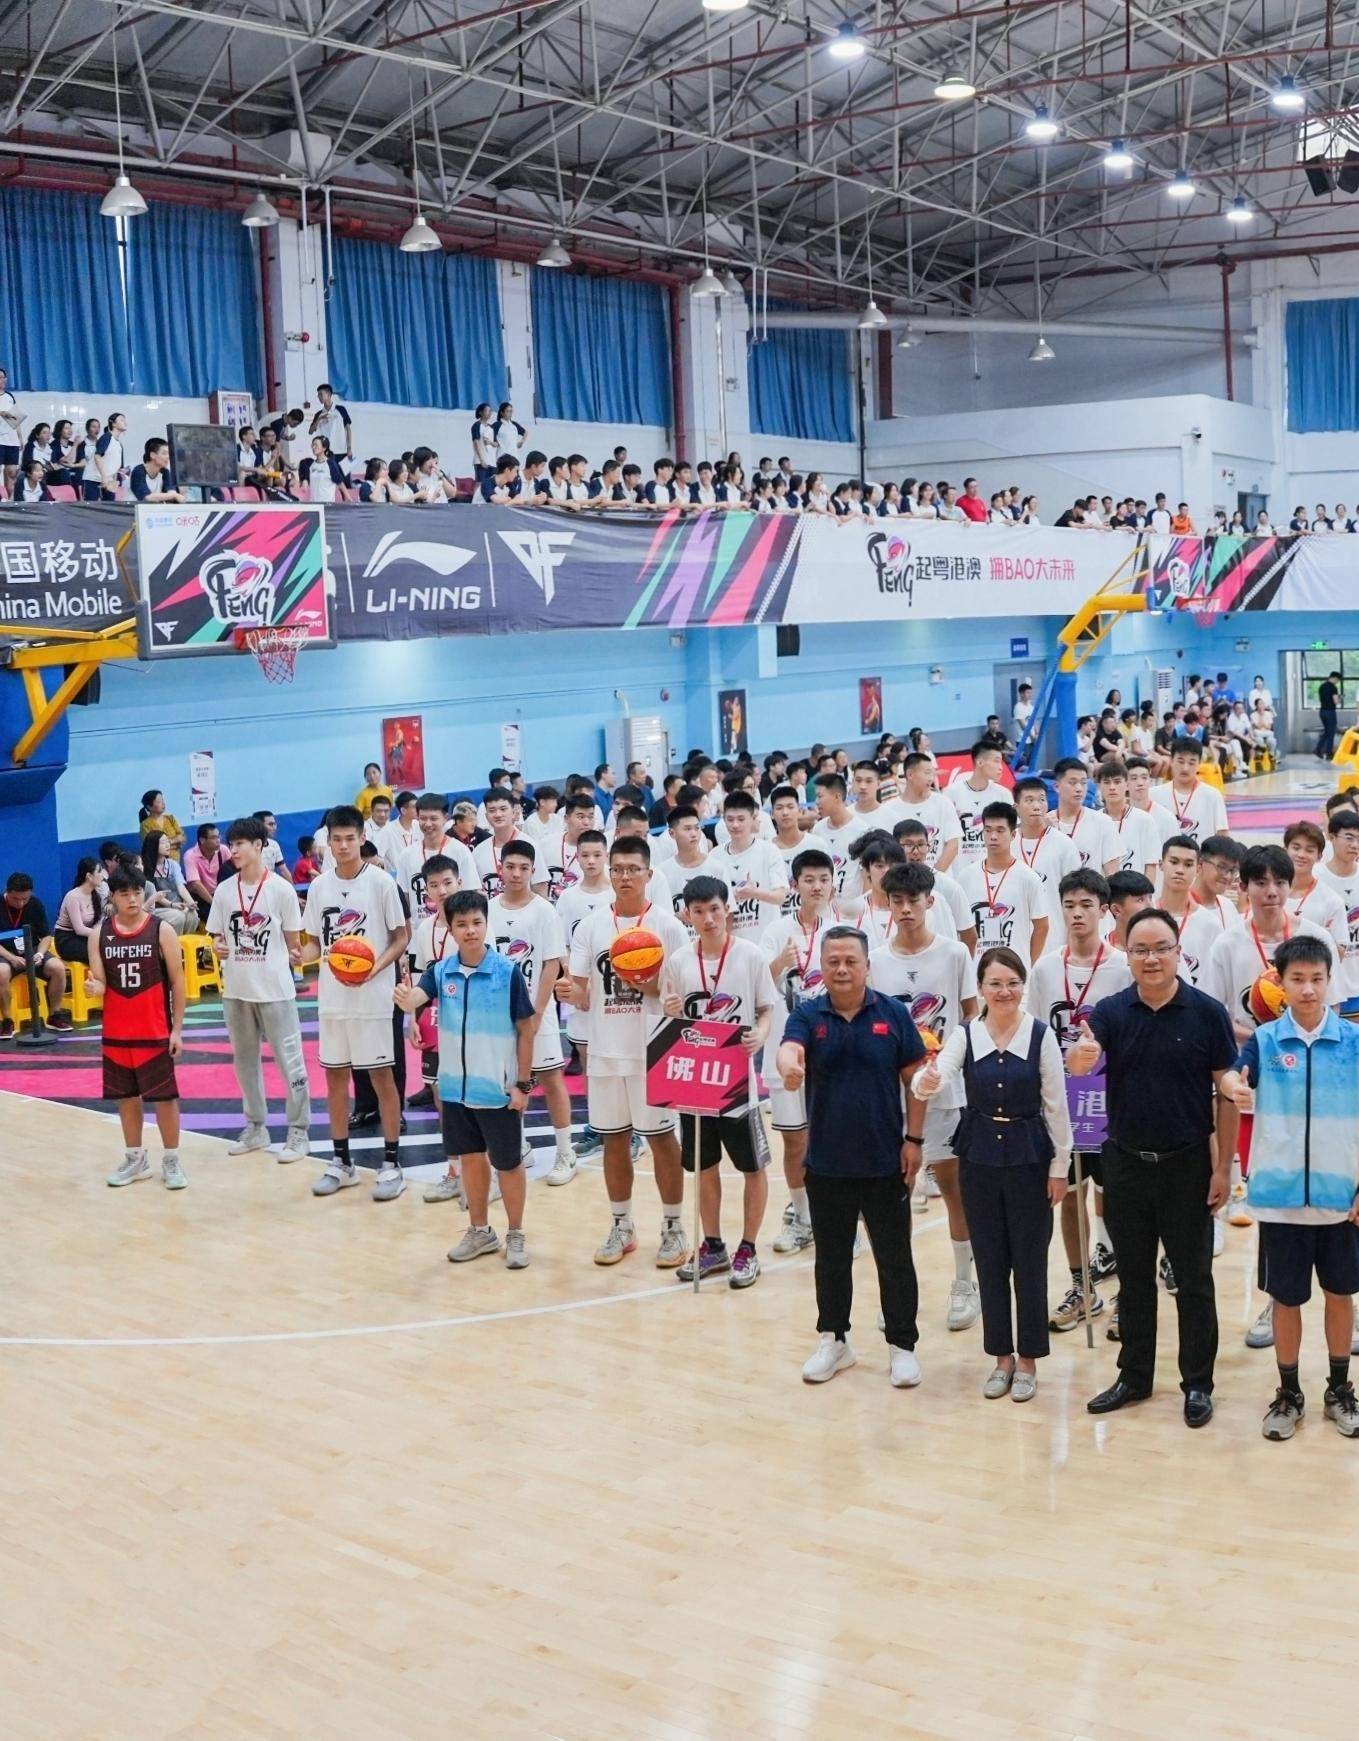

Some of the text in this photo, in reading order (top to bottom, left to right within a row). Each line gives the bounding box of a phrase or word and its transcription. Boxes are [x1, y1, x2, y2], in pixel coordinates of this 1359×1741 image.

[915, 556, 981, 581] 起粤港澳
[45, 588, 122, 617] Mobile
[366, 586, 481, 613] LI-NING
[117, 963, 140, 988] 15
[666, 1056, 731, 1086] 佛山
